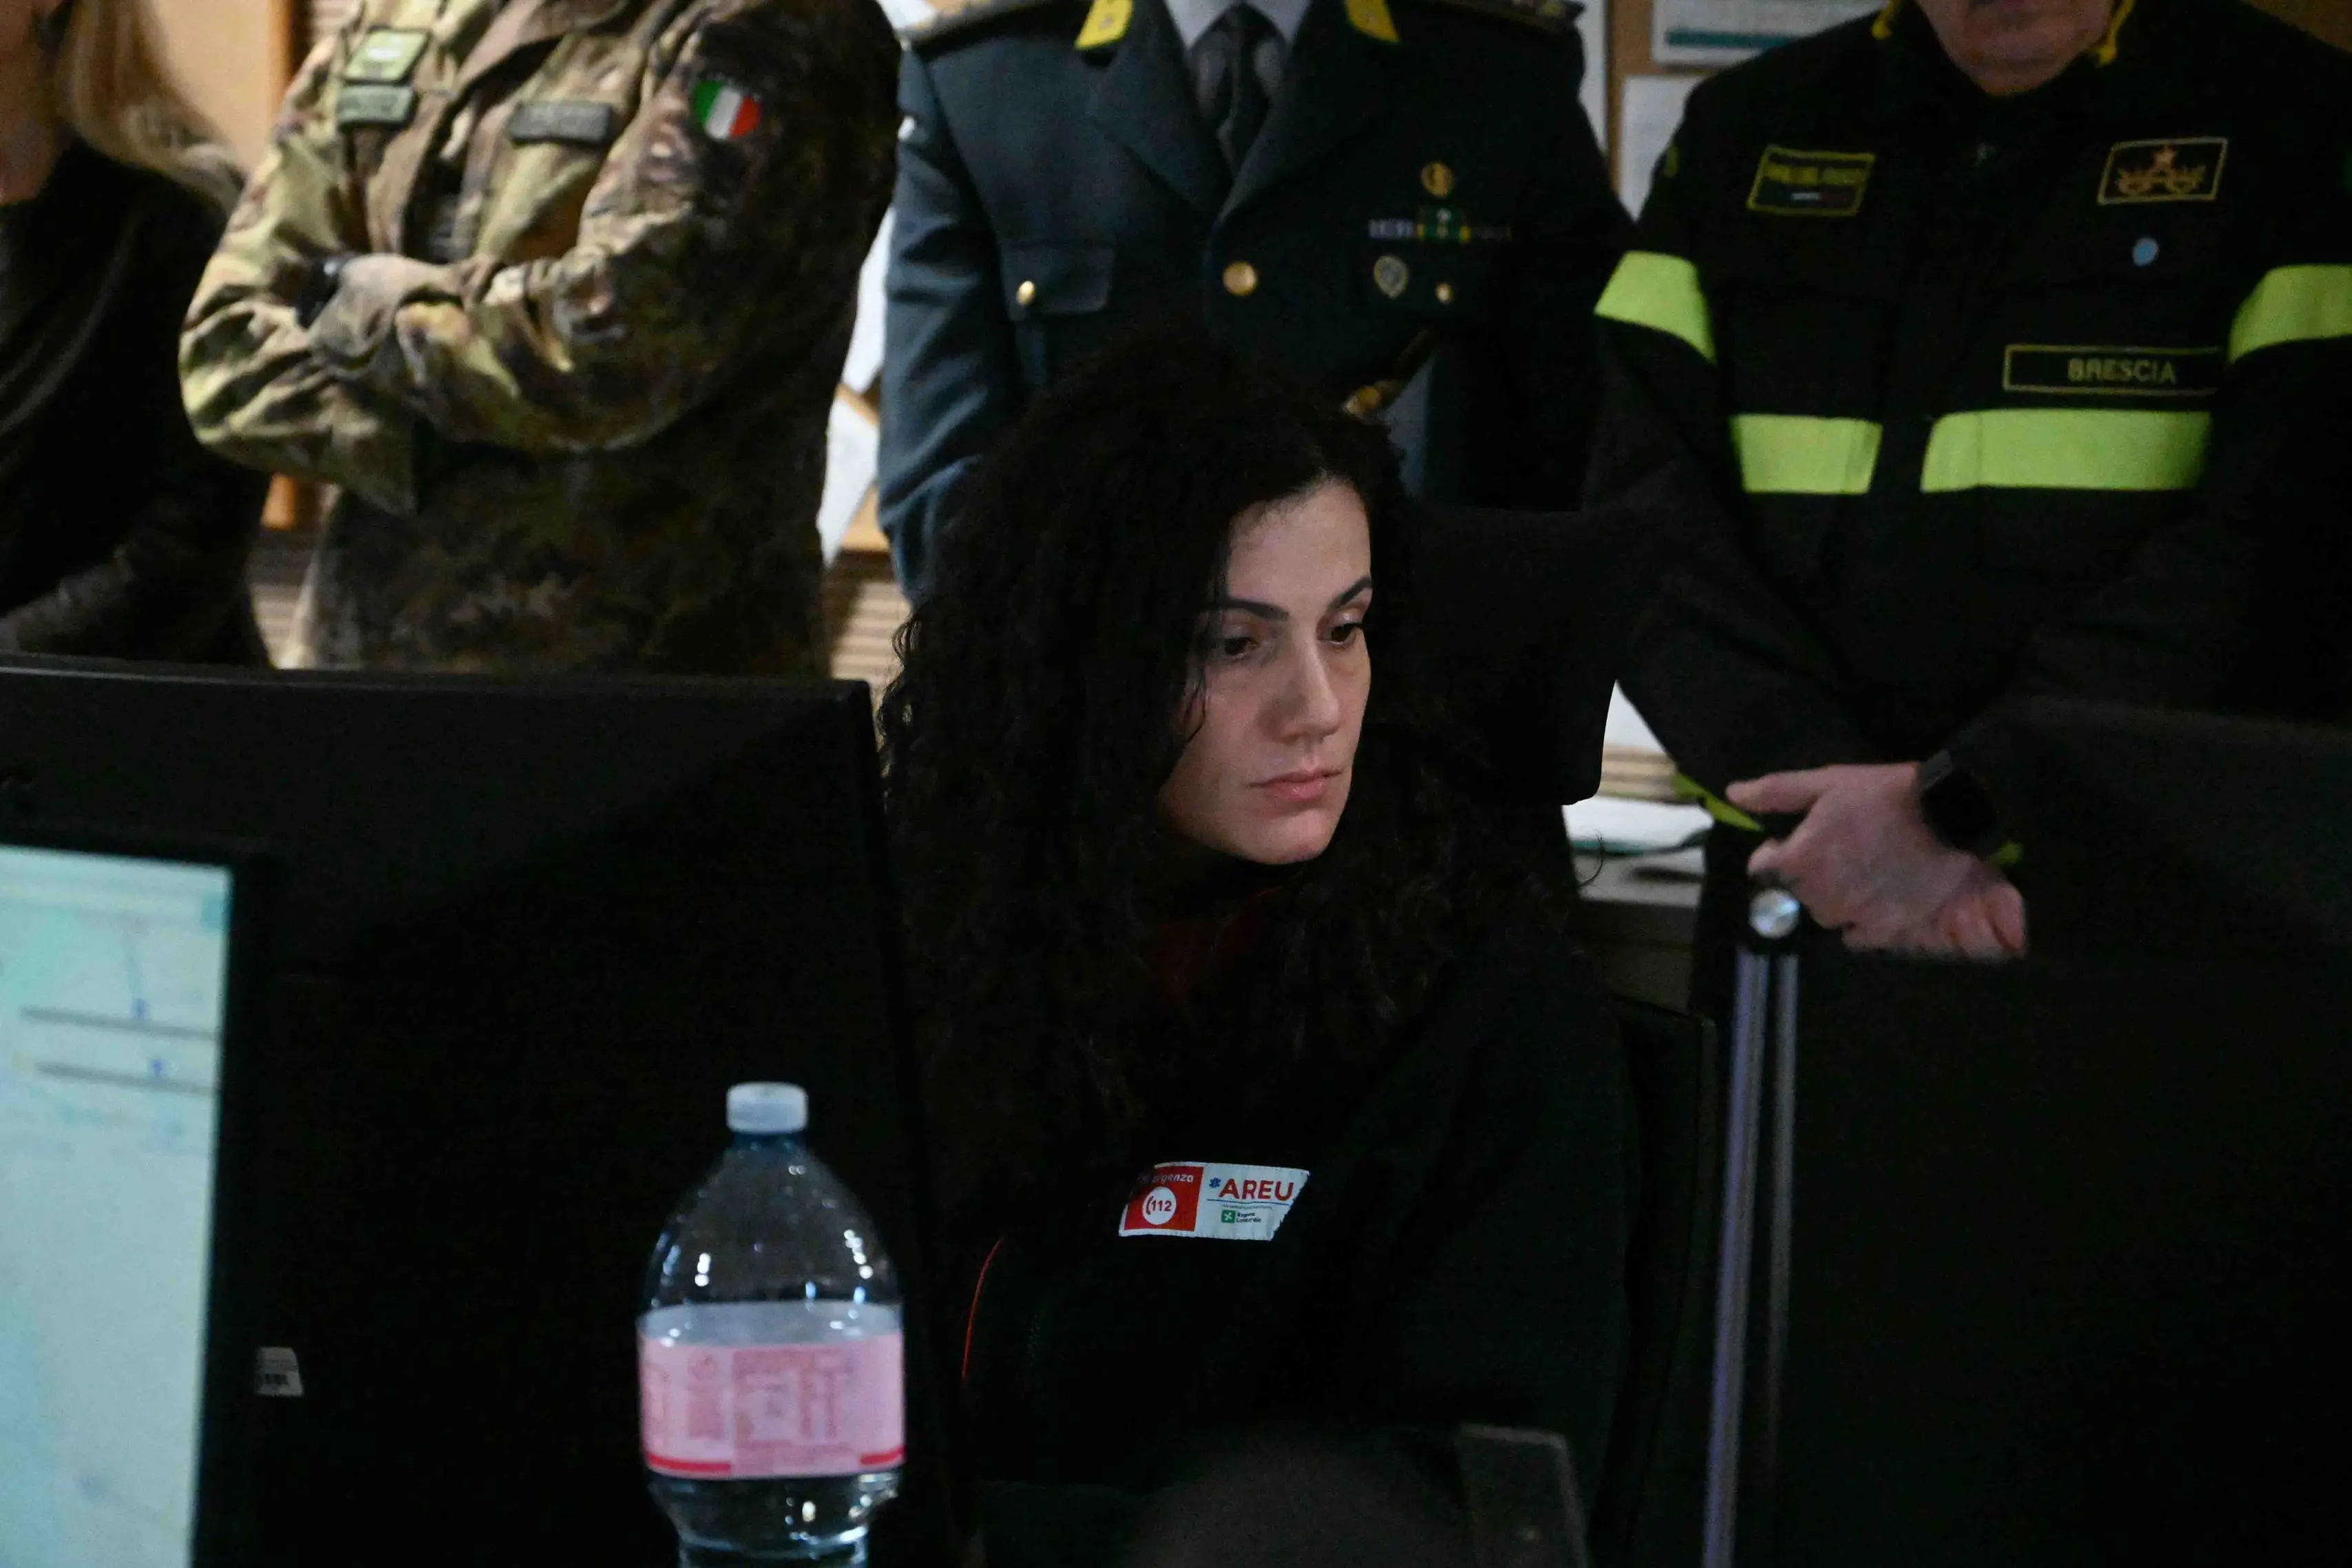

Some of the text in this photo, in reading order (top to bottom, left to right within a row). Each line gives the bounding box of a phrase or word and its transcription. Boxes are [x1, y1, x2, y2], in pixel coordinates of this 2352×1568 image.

[2067, 356, 2177, 385] BRESCIA
[1218, 1178, 1294, 1201] AREU
[1151, 1199, 1173, 1213] 112
